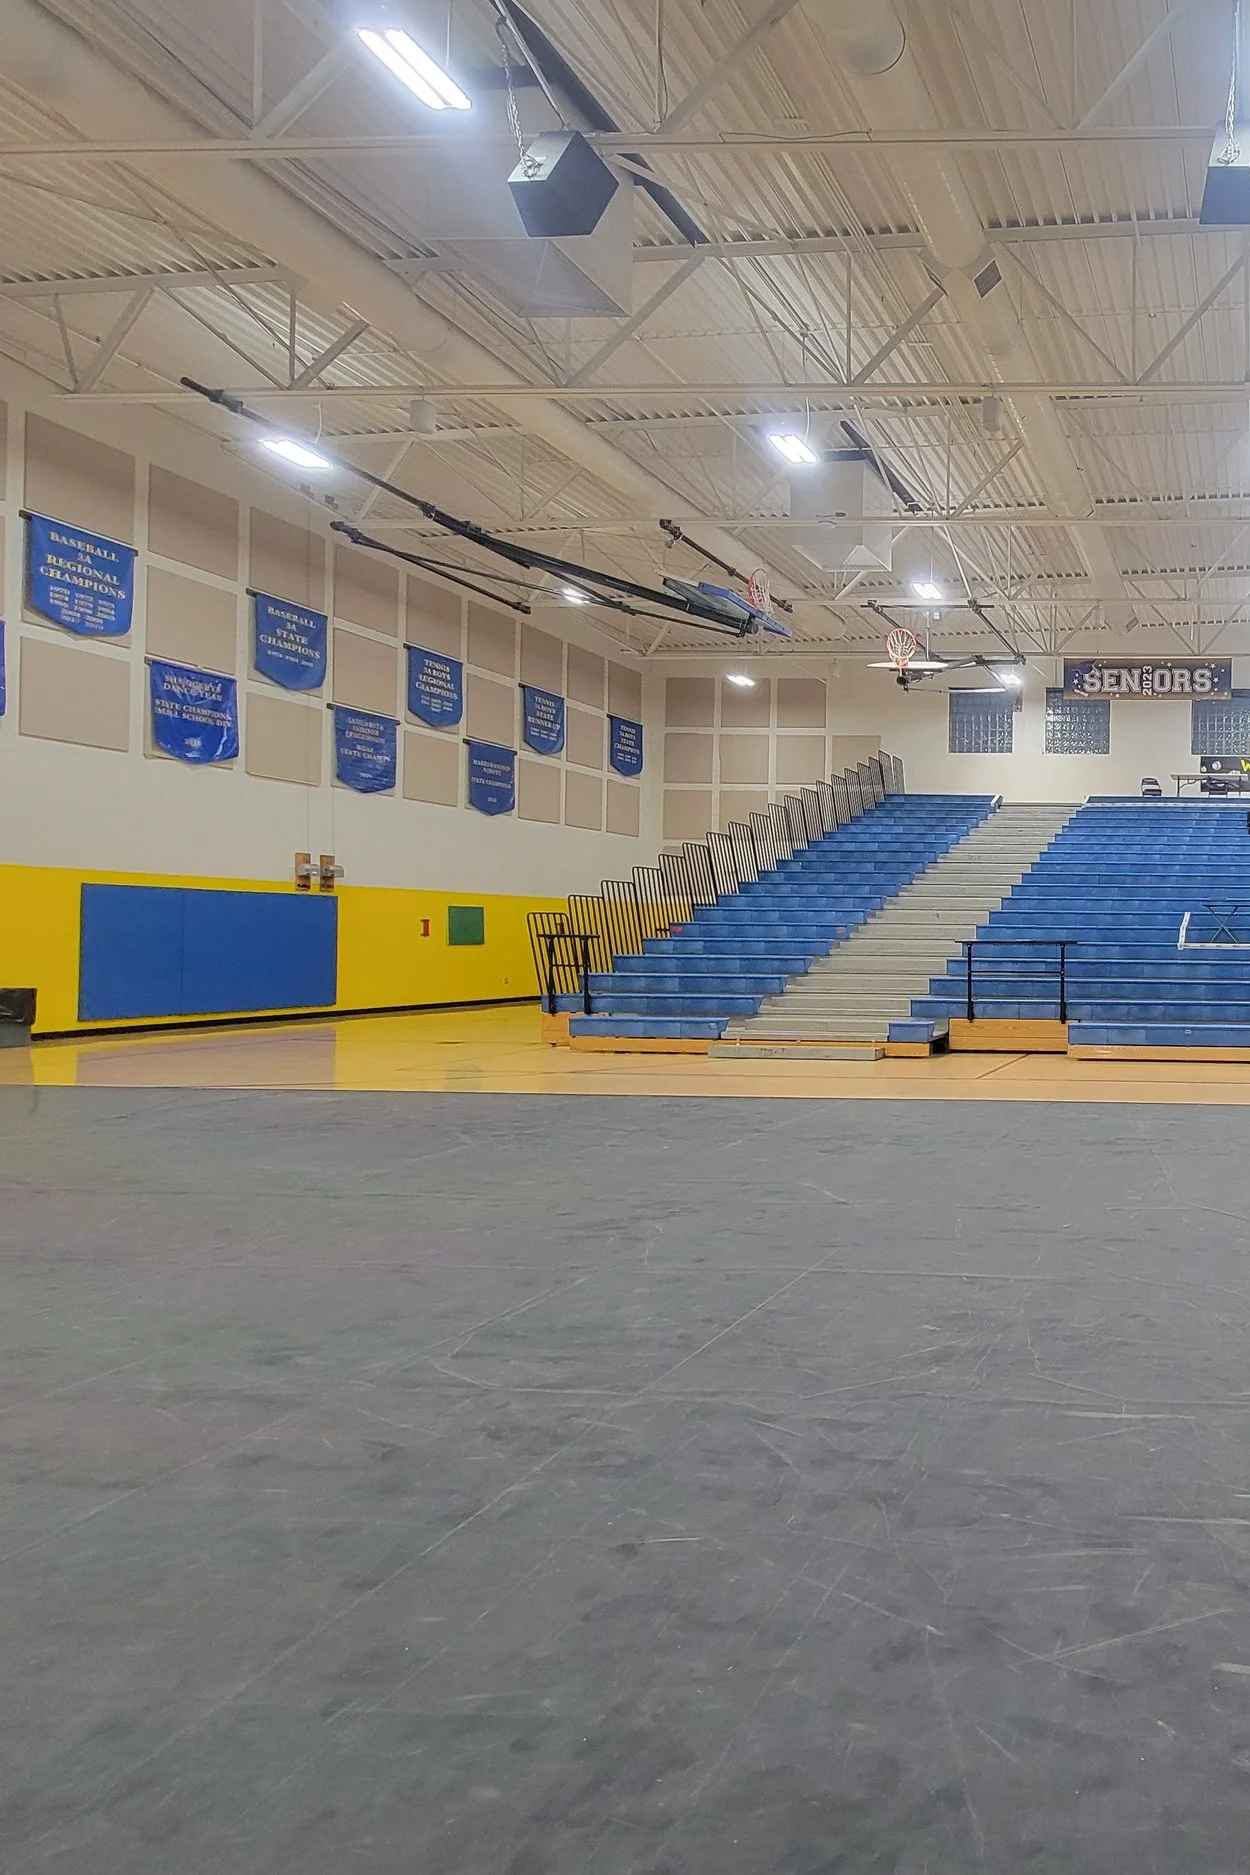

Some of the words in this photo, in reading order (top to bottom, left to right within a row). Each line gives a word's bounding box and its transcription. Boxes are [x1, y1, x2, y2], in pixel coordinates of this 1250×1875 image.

[50, 531, 119, 562] BASEBALL
[47, 554, 120, 586] REGIONAL
[40, 565, 126, 599] CHAMPIONS
[267, 606, 316, 629] BASEBALL
[260, 634, 321, 659] CHAMPIONS
[276, 628, 309, 645] STATE
[424, 659, 450, 673] TENNIS
[415, 682, 459, 700] CHAMPIONS
[418, 673, 455, 690] REGIONAL
[1142, 665, 1153, 696] 2023
[154, 699, 181, 711] STATE
[183, 705, 232, 721] CHAMPIONS
